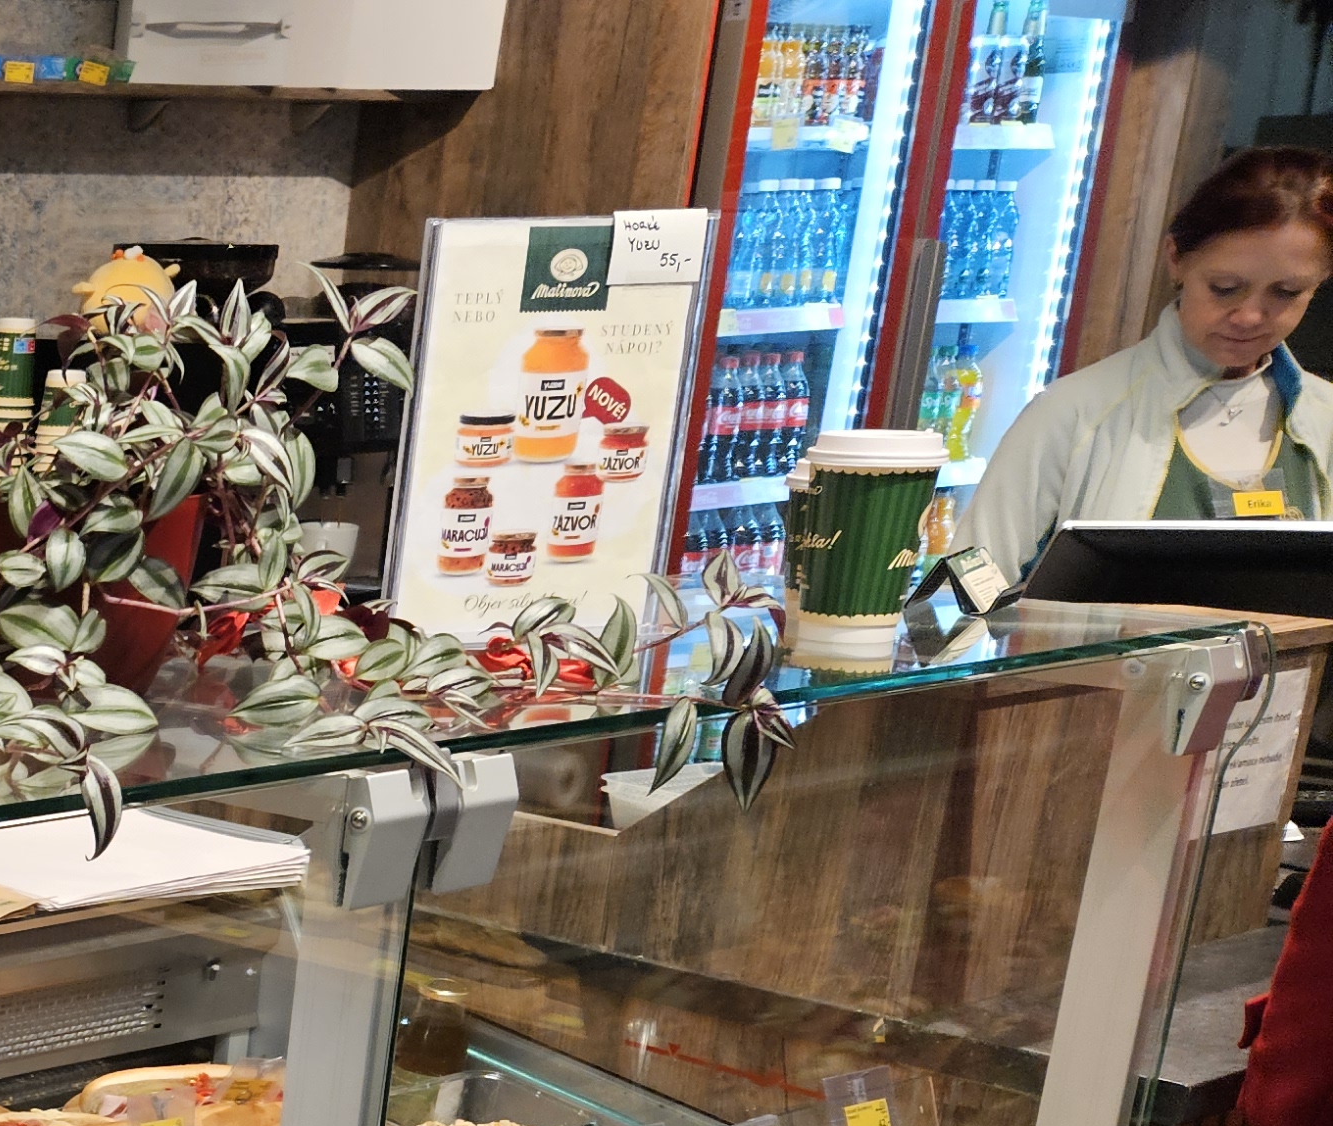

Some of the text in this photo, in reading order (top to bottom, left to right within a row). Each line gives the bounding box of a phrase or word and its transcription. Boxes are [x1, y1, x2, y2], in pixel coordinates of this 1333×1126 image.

[628, 237, 661, 252] YUZU
[660, 253, 692, 272] 55,-
[454, 290, 505, 305] TEPLÝ
[452, 311, 496, 323] NEBO
[600, 321, 675, 337] STUDENÝ
[604, 341, 664, 356] NÁPOJ?
[524, 393, 578, 421] YUZU
[588, 384, 627, 421] NOVÉ!
[471, 443, 500, 456] YUZU
